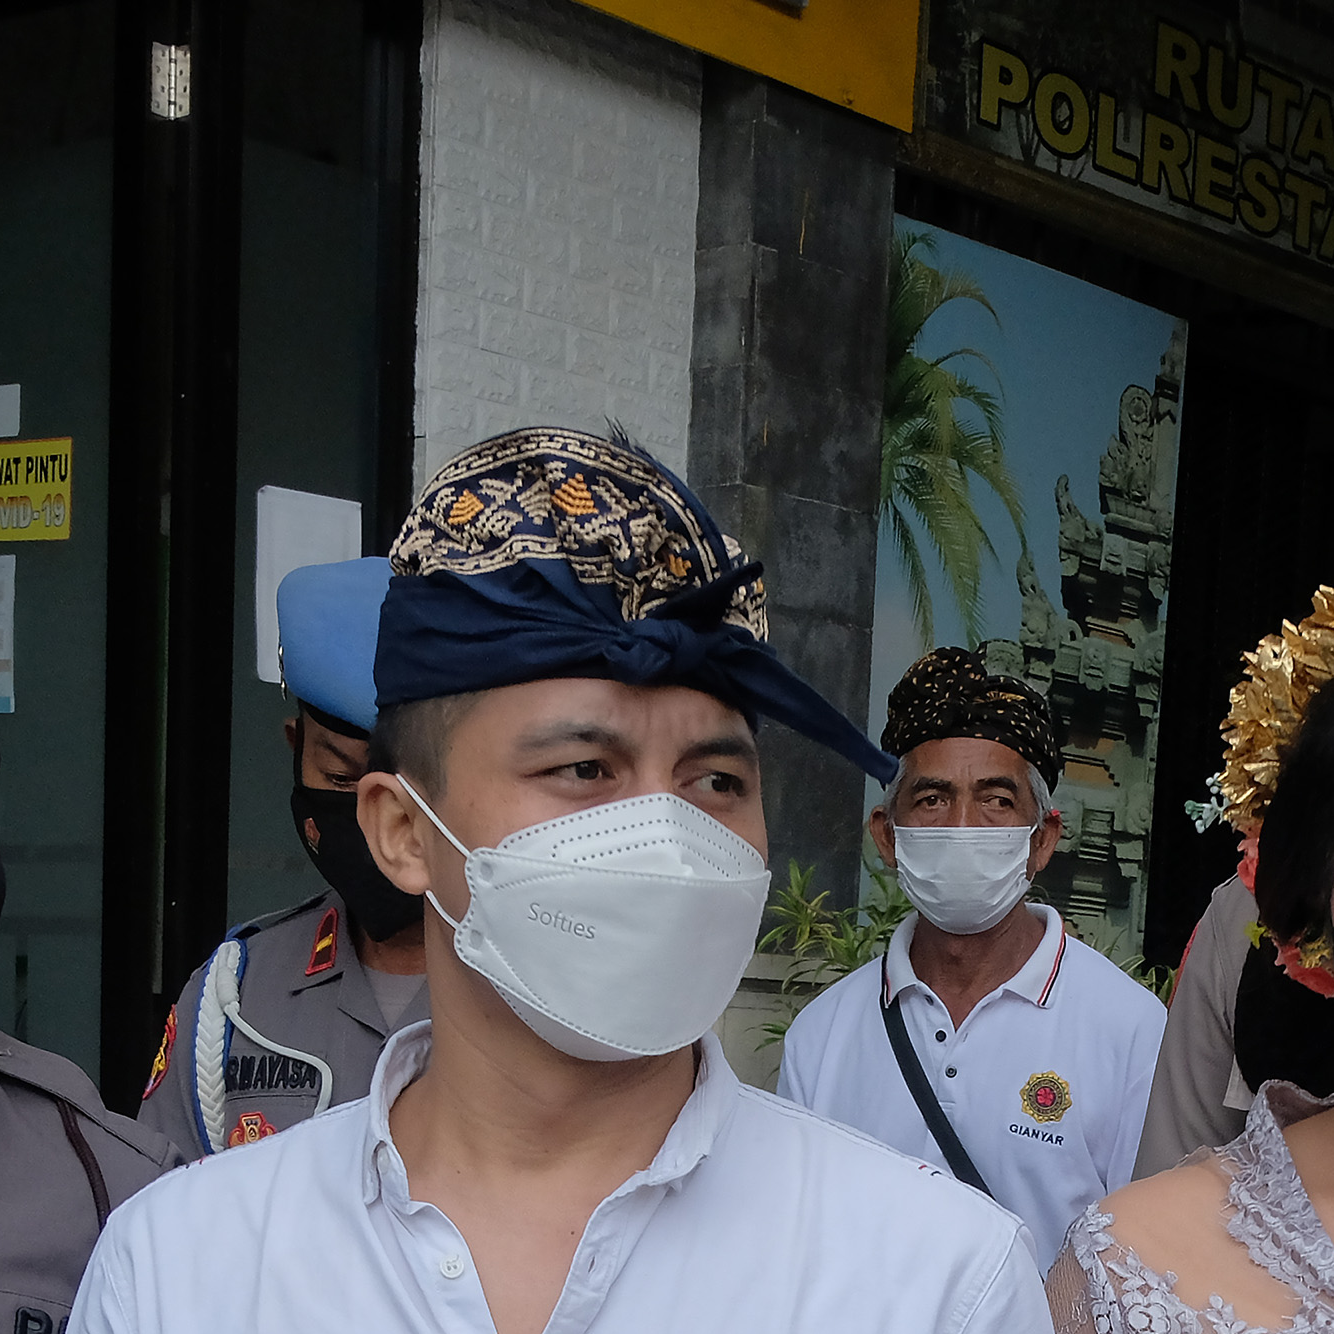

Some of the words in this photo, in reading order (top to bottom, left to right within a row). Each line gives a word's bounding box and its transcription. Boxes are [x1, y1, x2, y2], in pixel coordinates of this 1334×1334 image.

[26, 453, 68, 484] PINTU
[527, 902, 596, 940] Softies
[226, 1055, 317, 1092] RMAYASA
[1009, 1123, 1064, 1145] GIANYAR
